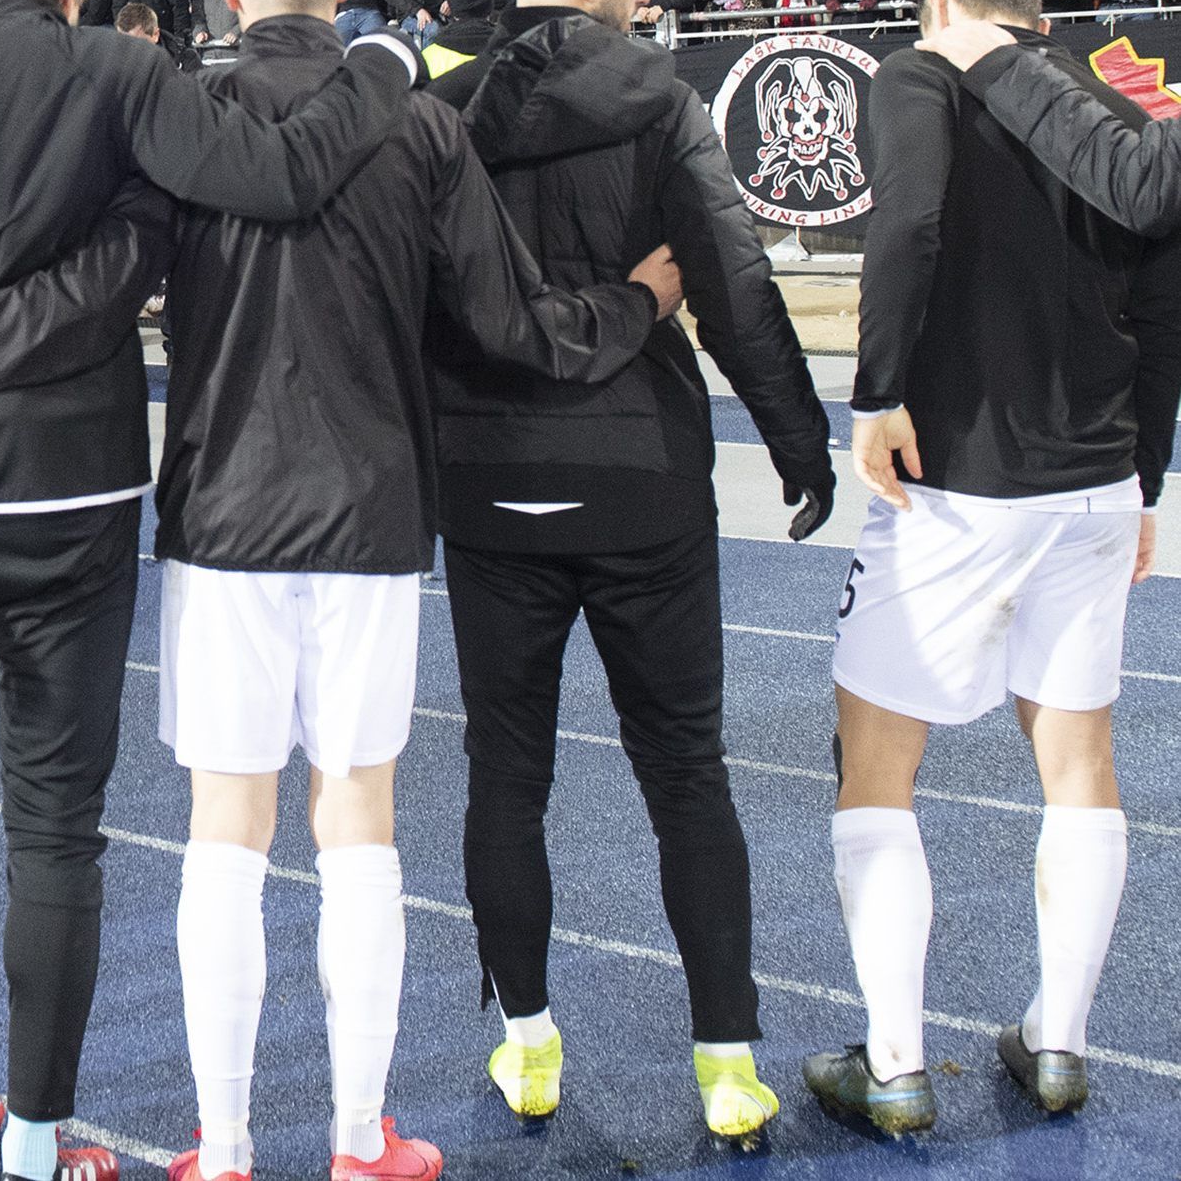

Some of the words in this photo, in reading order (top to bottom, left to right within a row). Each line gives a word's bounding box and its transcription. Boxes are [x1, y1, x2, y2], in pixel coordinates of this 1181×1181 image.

[732, 41, 777, 79] LASK
[787, 36, 875, 79] FANKLU
[820, 196, 872, 227] LINZ
